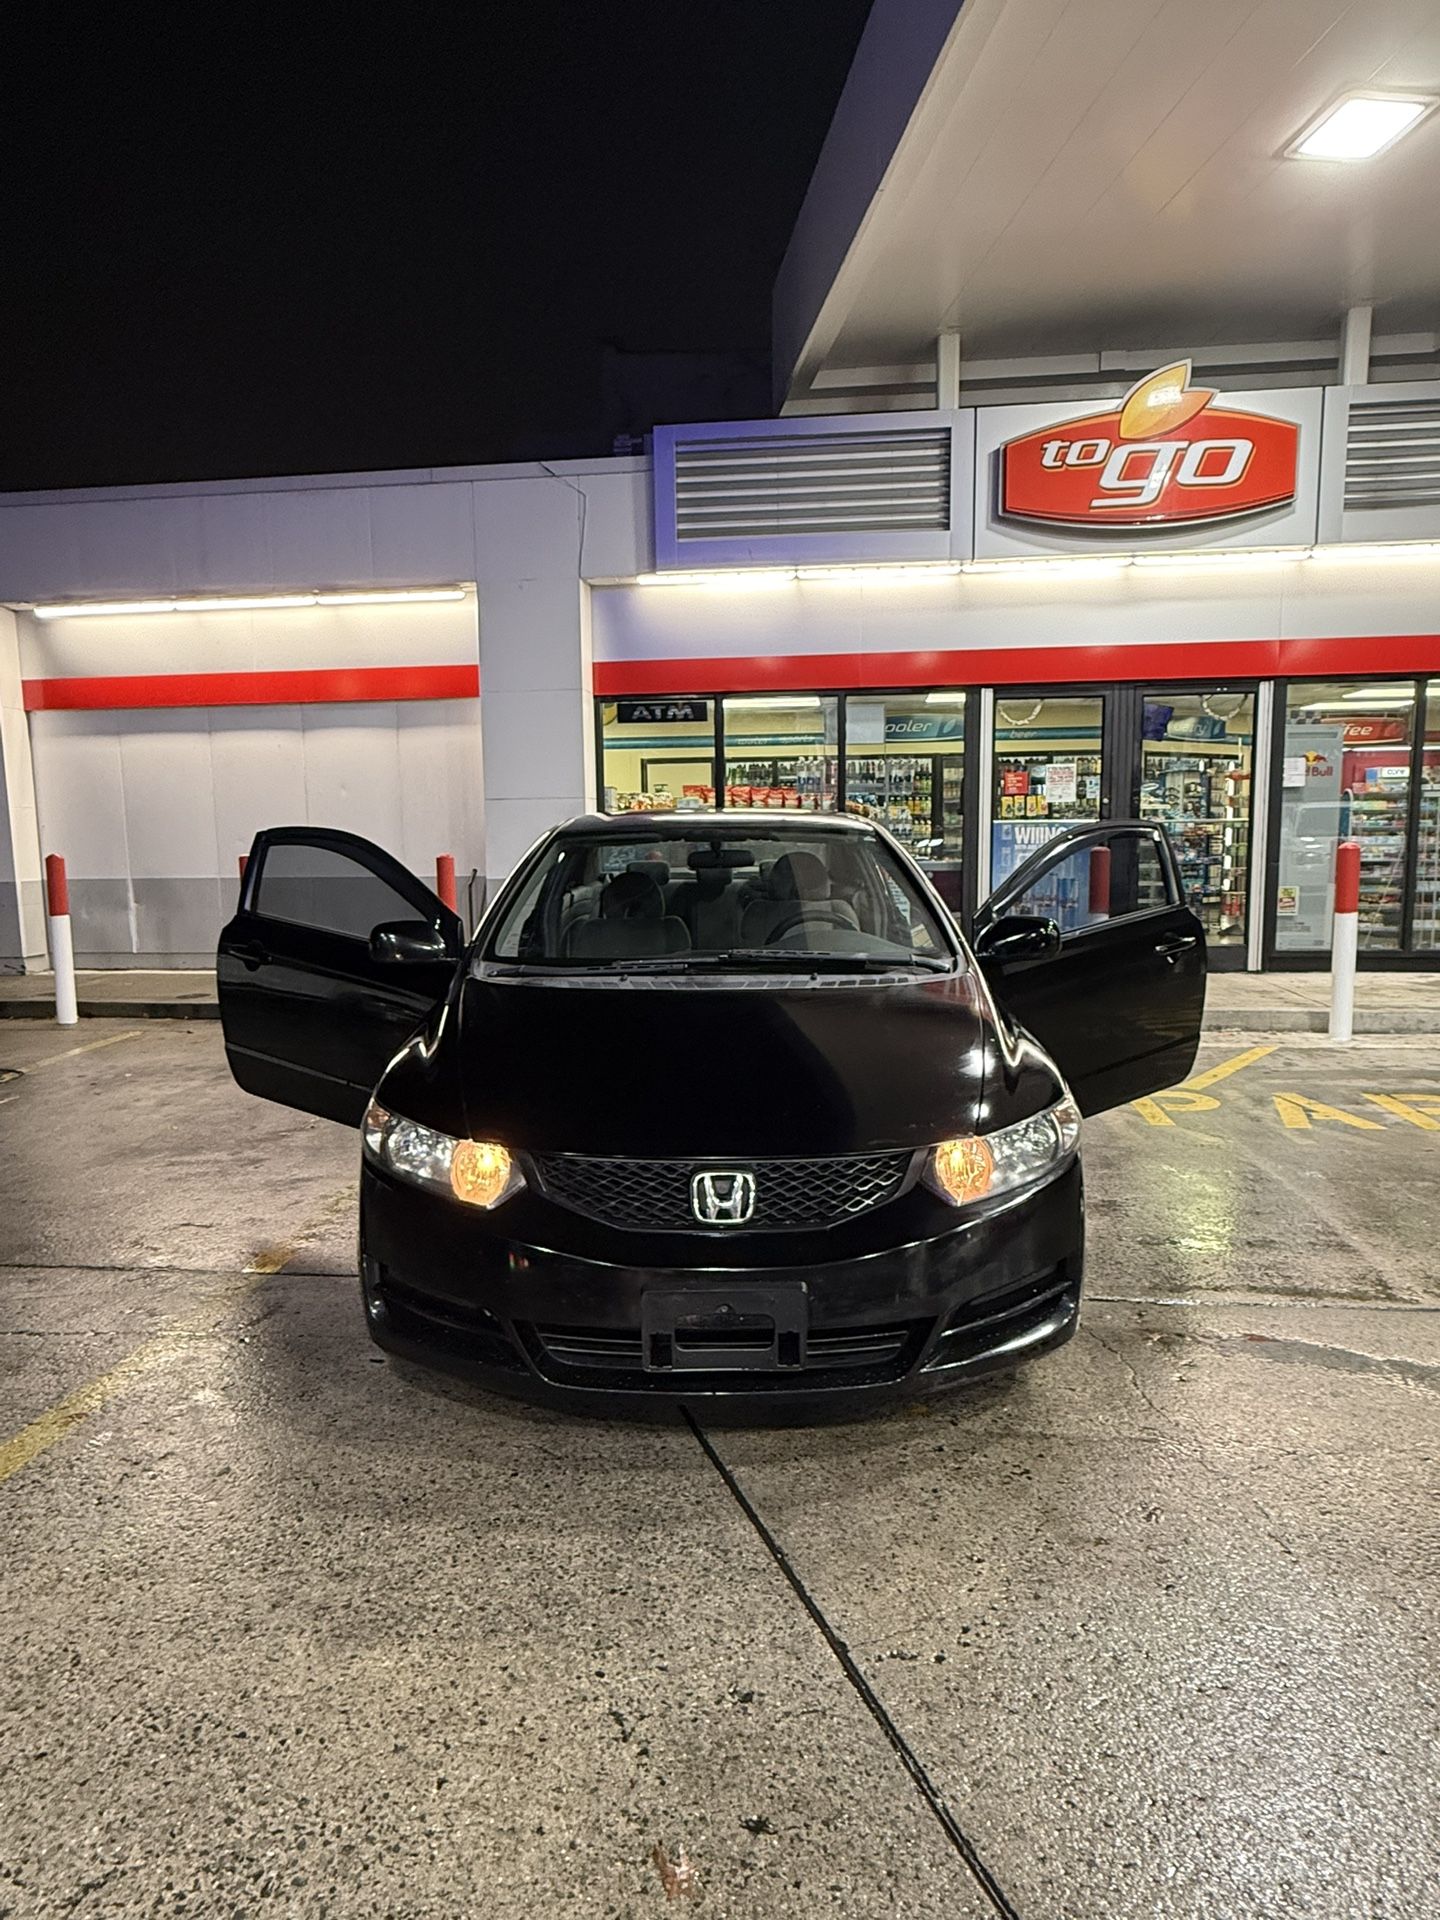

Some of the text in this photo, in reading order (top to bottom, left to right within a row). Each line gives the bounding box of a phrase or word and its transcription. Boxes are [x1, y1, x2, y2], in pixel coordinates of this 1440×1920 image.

[1041, 438, 1111, 468] to
[1089, 438, 1254, 509] go
[631, 705, 695, 720] ATM
[885, 719, 932, 733] ooler
[1343, 723, 1374, 736] fee
[1311, 765, 1334, 777] Bull
